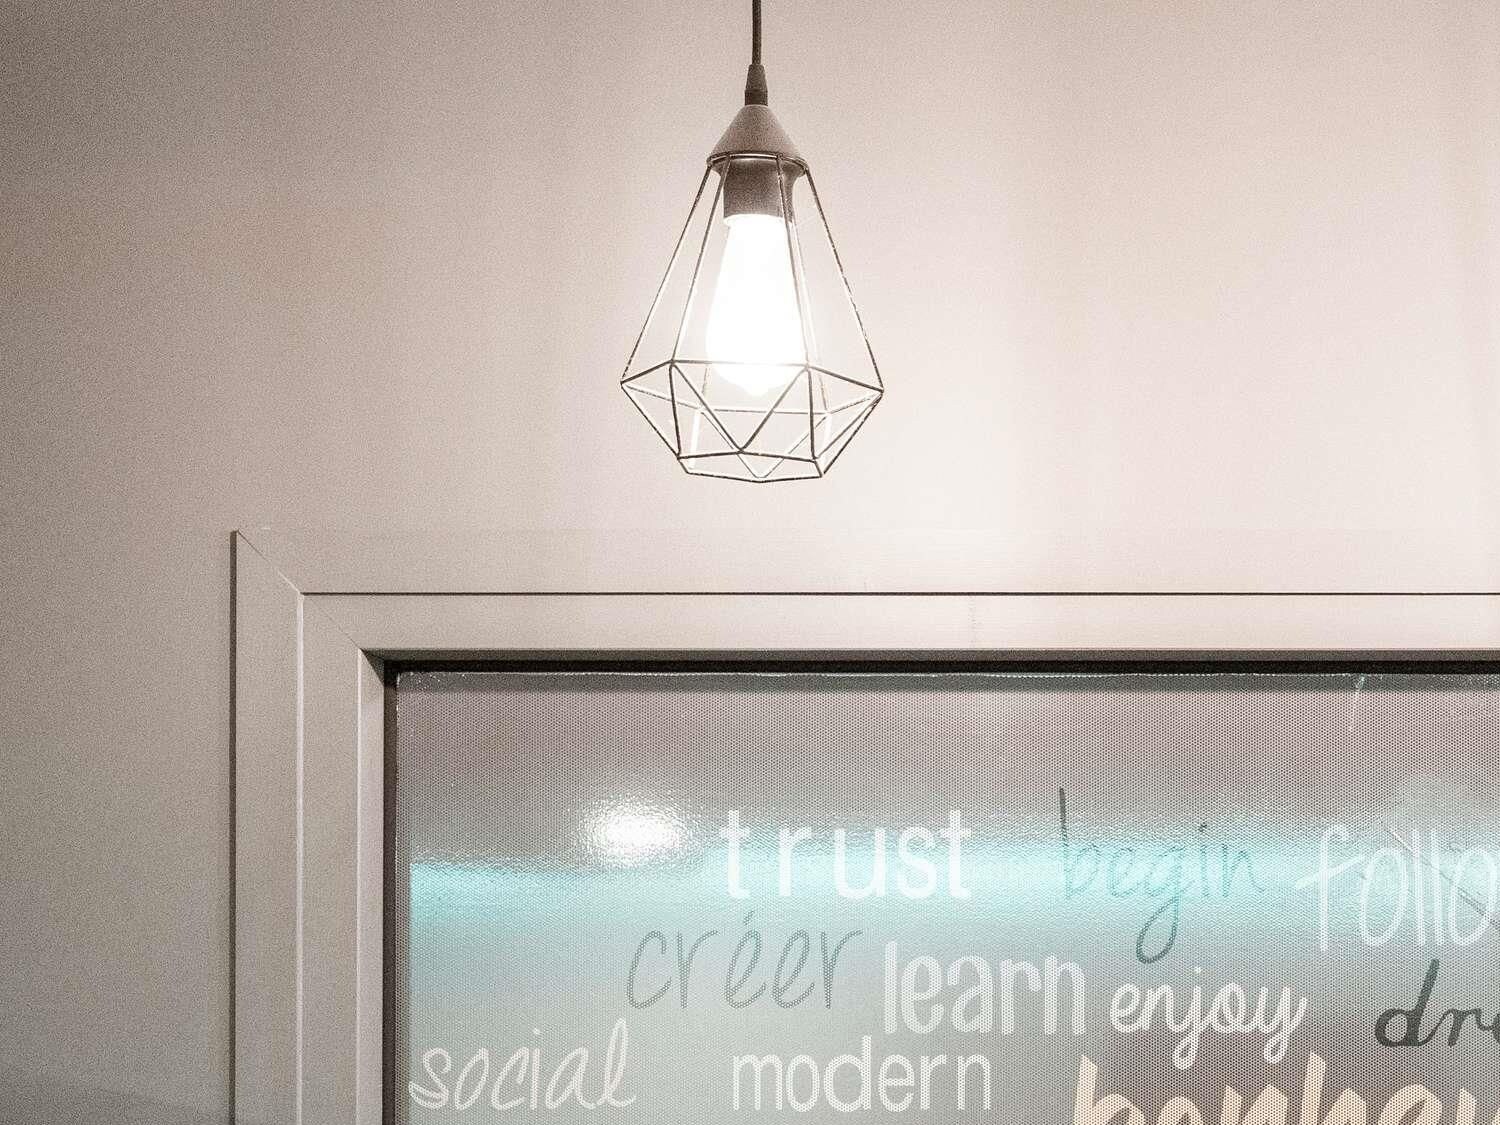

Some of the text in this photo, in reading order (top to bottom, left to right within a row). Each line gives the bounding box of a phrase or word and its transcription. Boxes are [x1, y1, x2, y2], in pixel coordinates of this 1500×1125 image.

[719, 808, 972, 899] trust
[1058, 786, 1266, 965] begin
[626, 909, 863, 1010] créer
[883, 941, 1087, 1035] learn
[408, 1017, 637, 1111] social
[1109, 966, 1308, 1070] enjoy
[731, 1035, 992, 1113] modern
